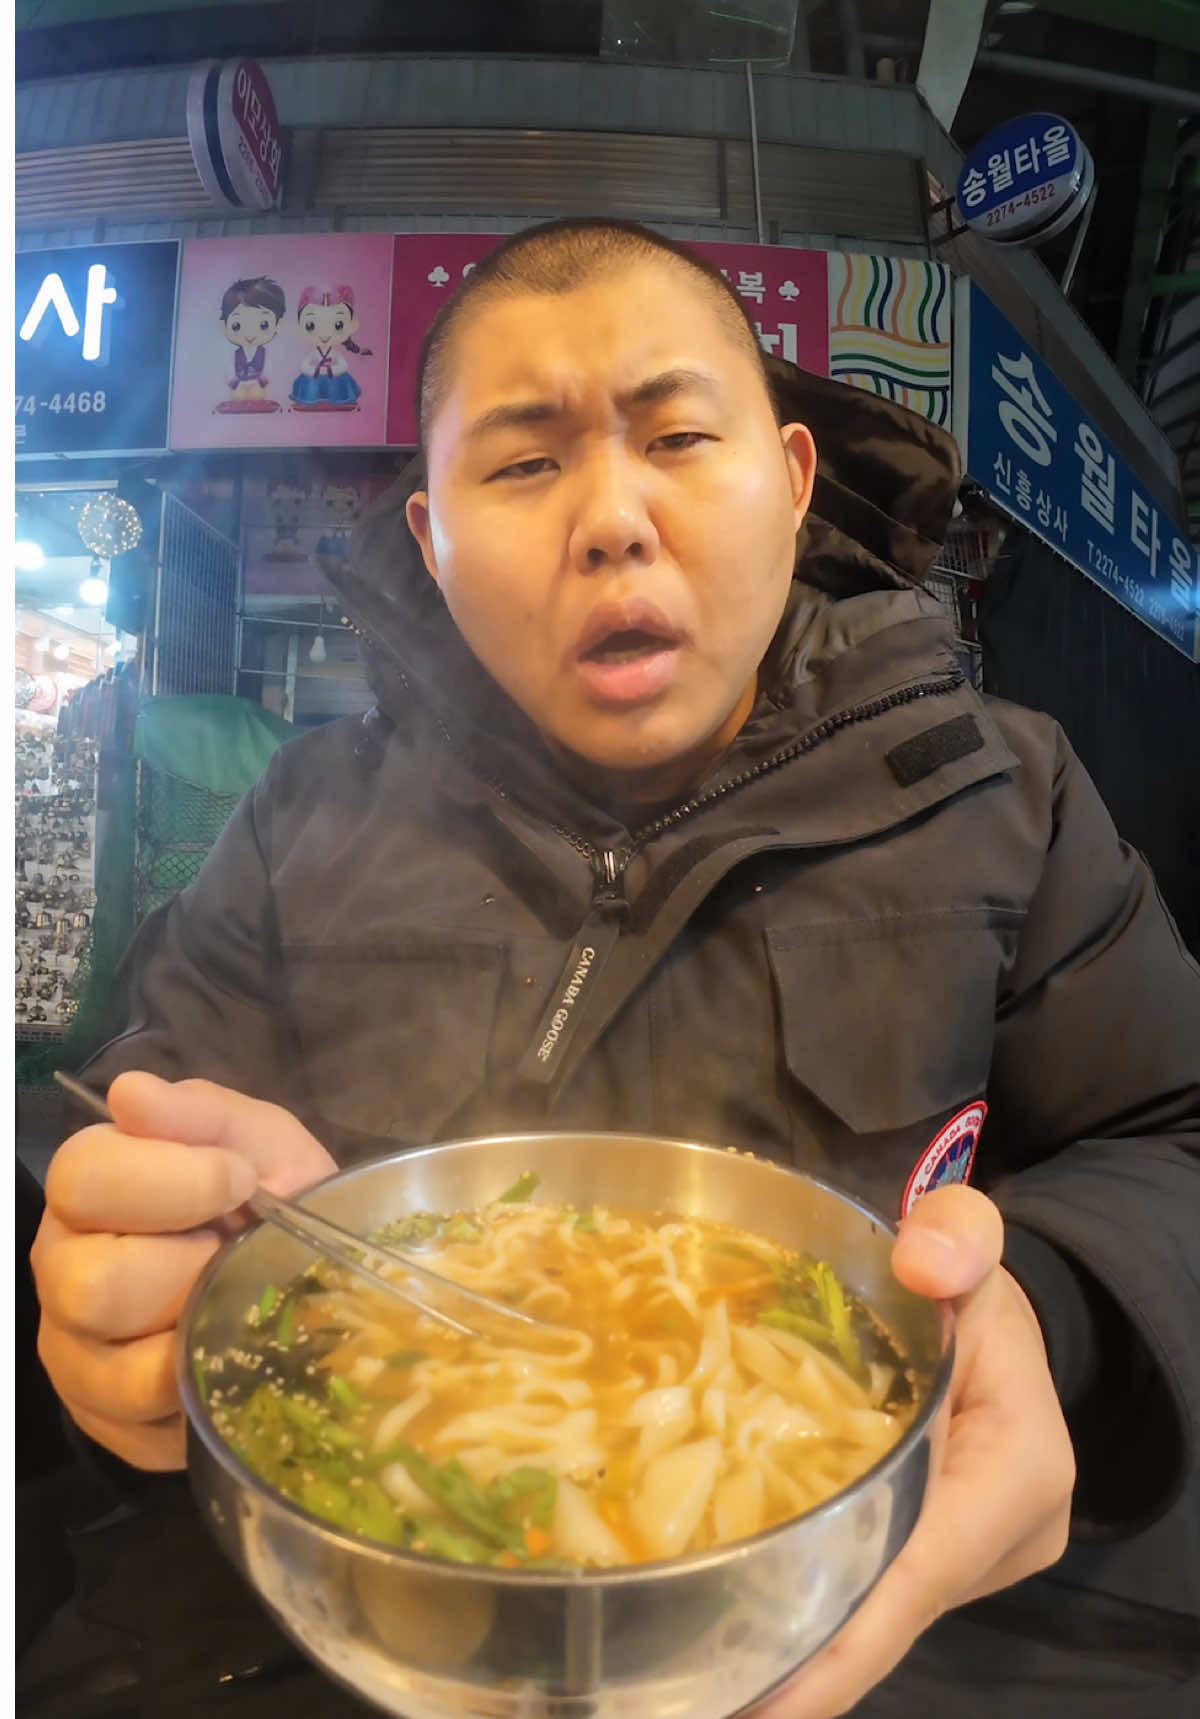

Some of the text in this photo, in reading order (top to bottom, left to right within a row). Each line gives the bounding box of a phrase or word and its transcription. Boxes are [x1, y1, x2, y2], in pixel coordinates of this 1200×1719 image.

[962, 125, 1071, 207] 송월타올
[987, 183, 1056, 227] 2274-4522
[19, 263, 118, 361] 사
[993, 451, 1070, 543] 신흥상사
[536, 946, 596, 1063] CANADA GOOSE
